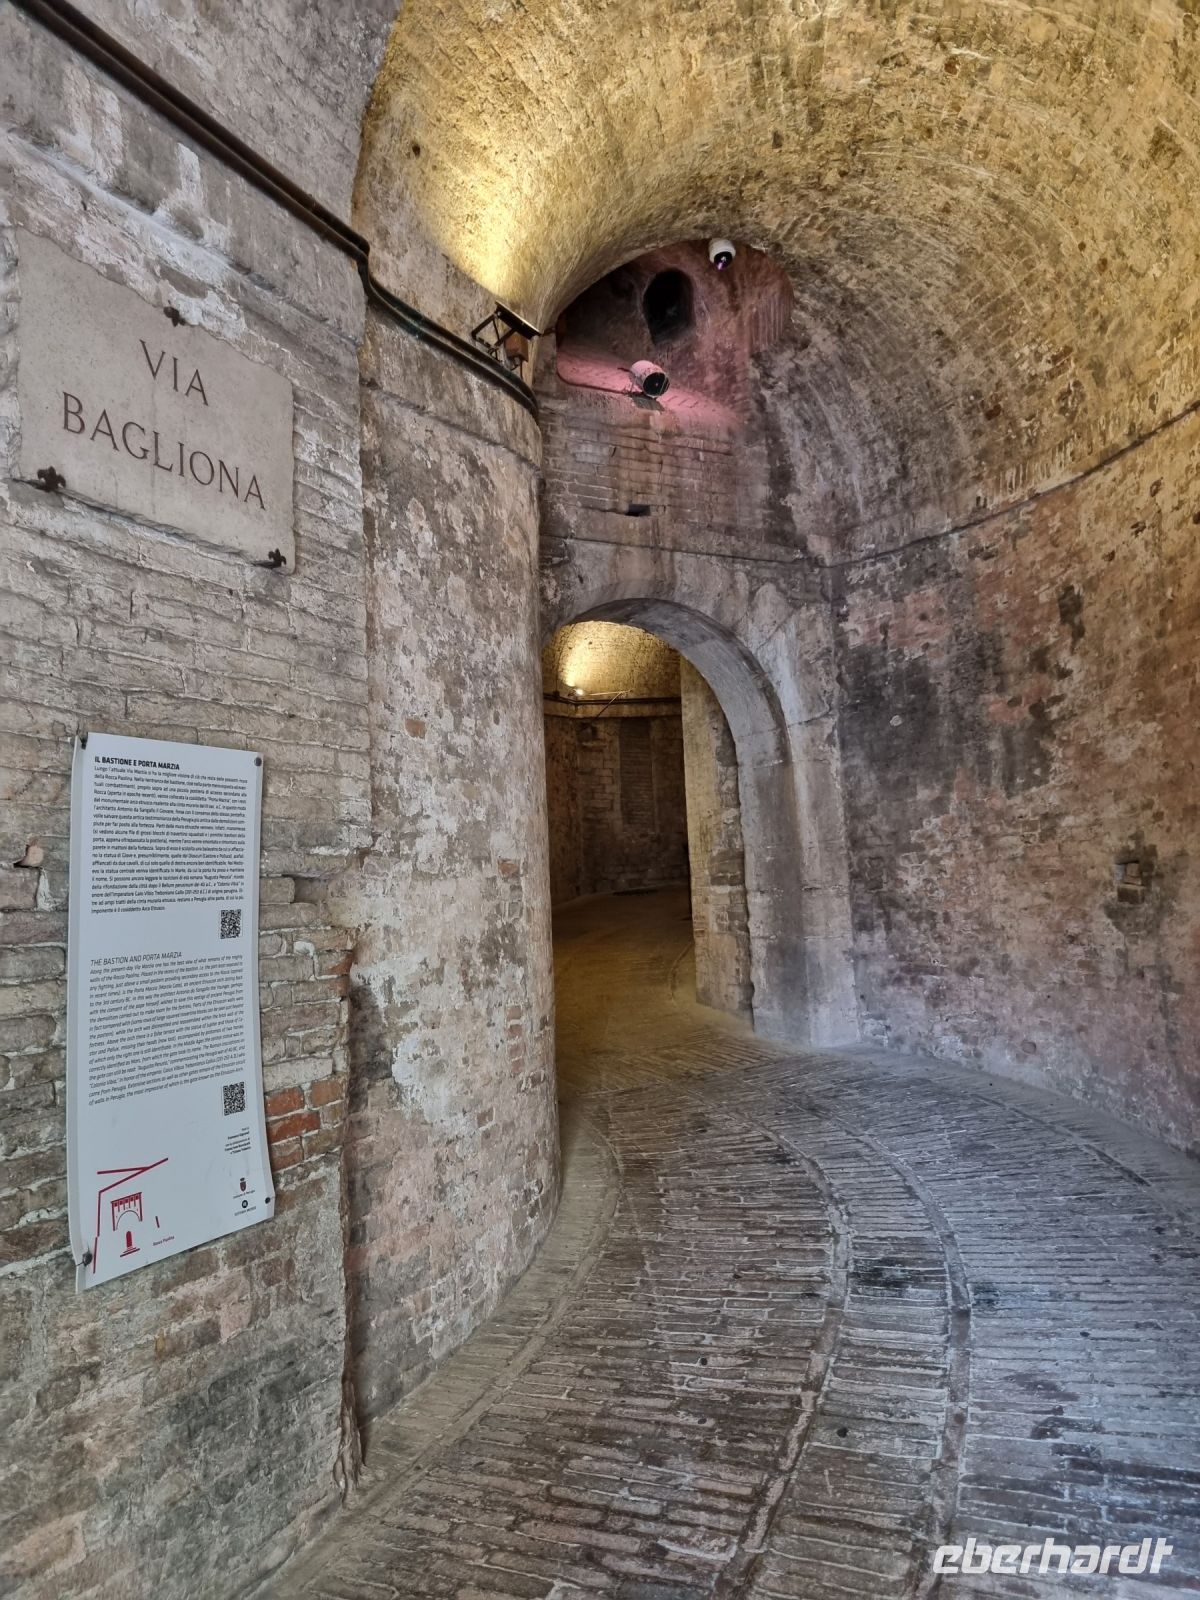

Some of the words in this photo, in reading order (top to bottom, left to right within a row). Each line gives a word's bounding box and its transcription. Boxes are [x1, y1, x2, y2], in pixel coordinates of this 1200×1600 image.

[140, 339, 208, 406] VIA
[62, 392, 266, 510] BAGLIONA
[102, 756, 132, 766] BASTIONE
[138, 760, 157, 768] PORTA
[103, 957, 128, 965] BASTION
[142, 953, 160, 961] PORTA
